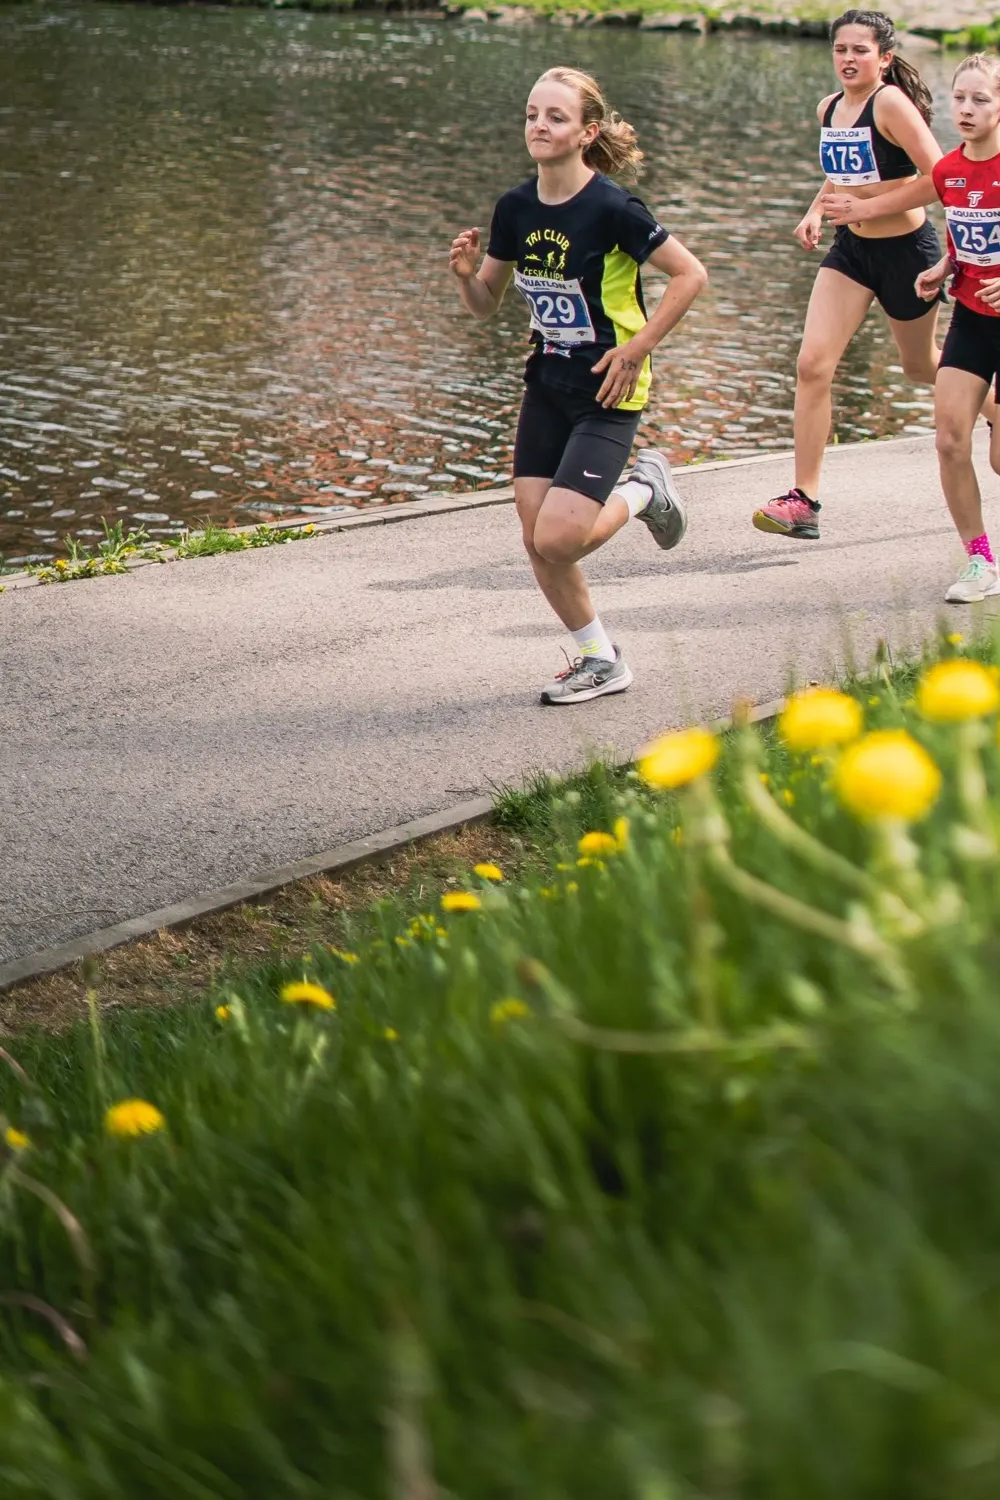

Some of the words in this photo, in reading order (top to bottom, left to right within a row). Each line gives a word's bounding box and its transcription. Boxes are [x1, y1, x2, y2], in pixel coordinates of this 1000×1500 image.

[827, 146, 863, 171] 175
[952, 210, 1000, 218] AQUATLON
[525, 229, 541, 247] TRI
[544, 229, 570, 251] CLUB
[523, 267, 548, 279] ČESKÁ
